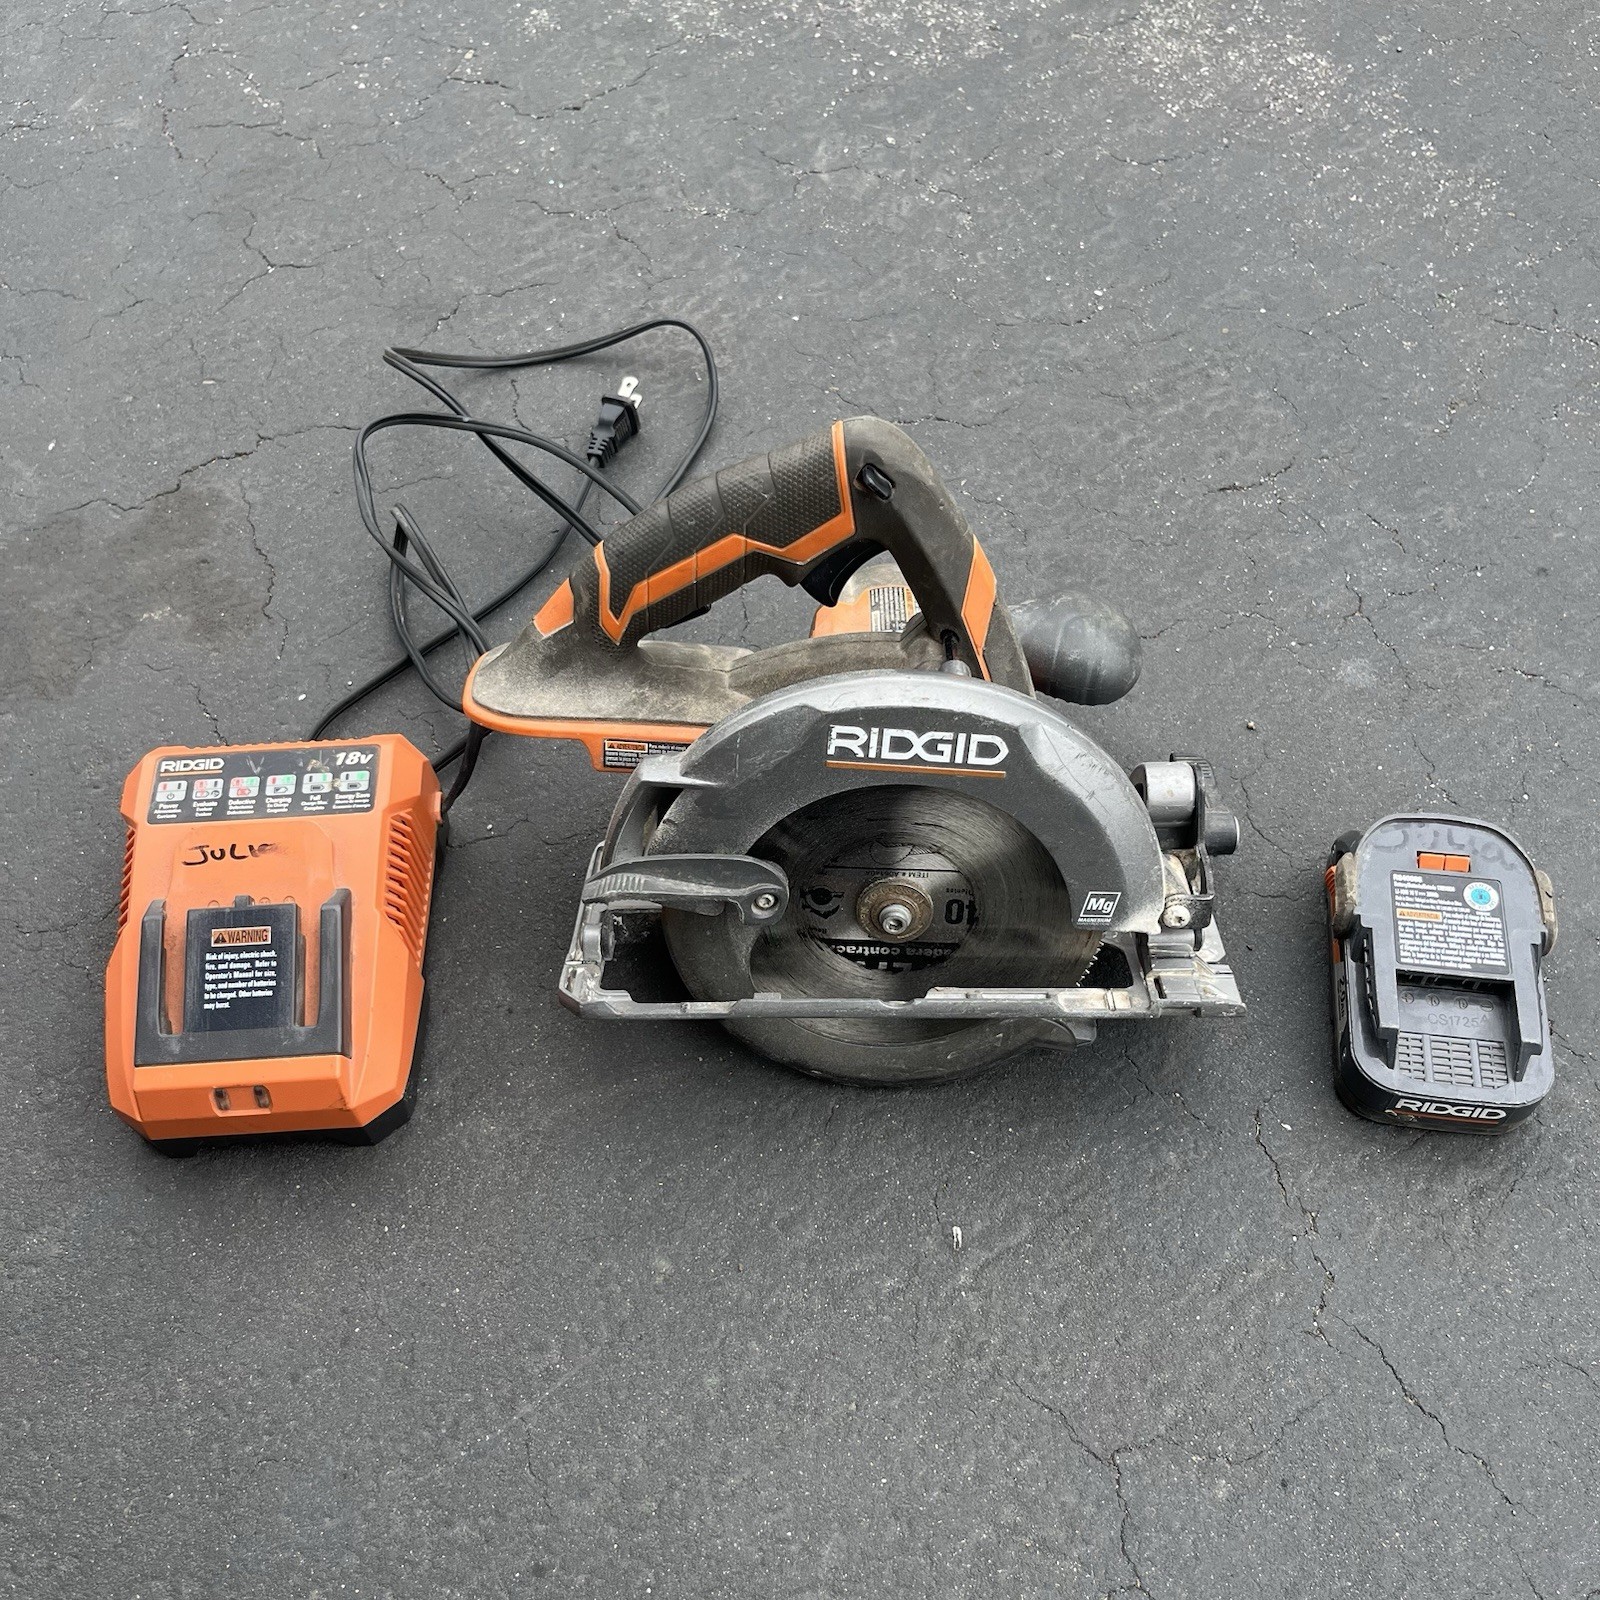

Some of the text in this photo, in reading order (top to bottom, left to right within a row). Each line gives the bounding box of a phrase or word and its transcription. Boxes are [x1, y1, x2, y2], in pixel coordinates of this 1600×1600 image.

[827, 724, 1010, 766] RIDGID
[336, 751, 374, 766] 18v
[160, 757, 224, 773] RIDGID
[1086, 898, 1114, 913] Mg
[227, 929, 268, 944] WARNING
[206, 952, 218, 960] Risk
[218, 952, 223, 960] of
[224, 952, 239, 961] injury,
[240, 951, 259, 959] electric
[831, 945, 901, 956] contrac
[218, 962, 228, 970] and
[229, 962, 252, 970] damage.
[205, 972, 232, 981] Operator's
[233, 970, 254, 978] Manual
[218, 981, 228, 989] and
[228, 980, 247, 989] number
[248, 980, 253, 988] of
[253, 979, 276, 987] batteries
[238, 990, 252, 998] Other
[252, 989, 273, 997] batteries
[203, 1003, 215, 1011] may
[1395, 1098, 1507, 1120] RIDGID
